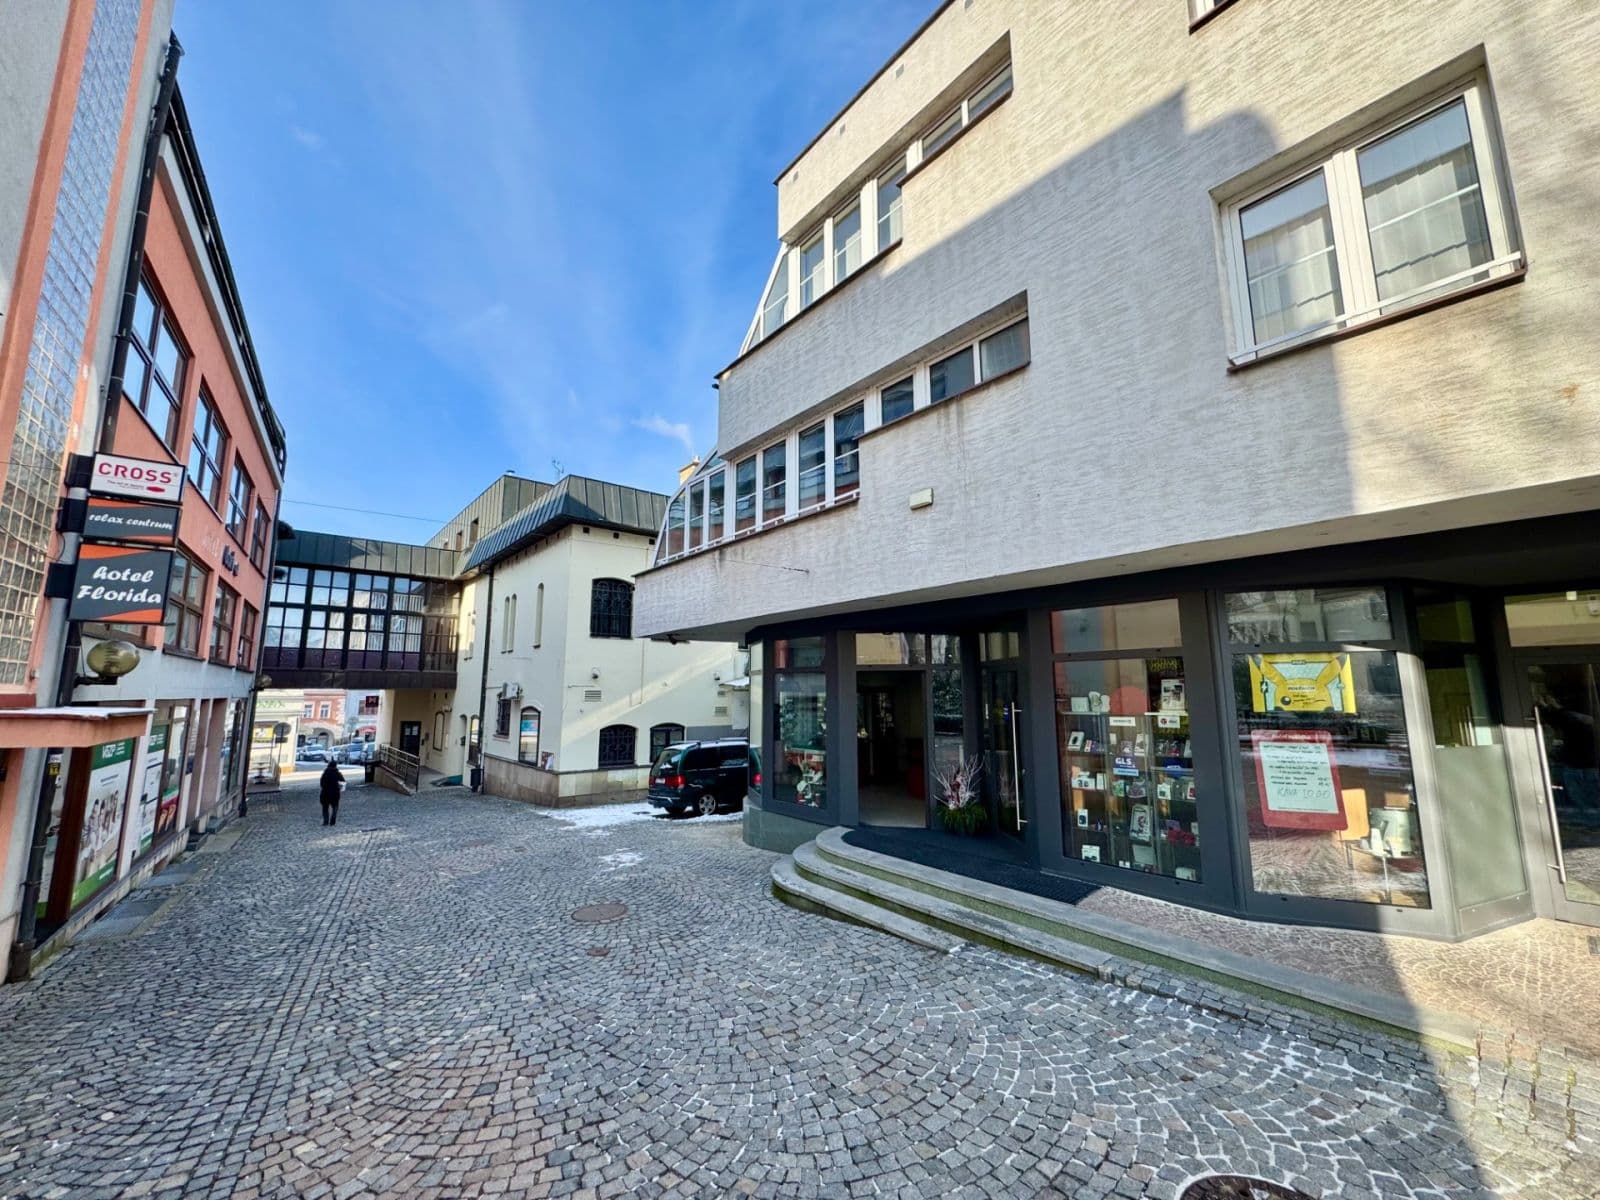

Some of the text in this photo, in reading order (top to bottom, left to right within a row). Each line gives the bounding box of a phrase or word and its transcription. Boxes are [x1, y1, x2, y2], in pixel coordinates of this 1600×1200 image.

[98, 462, 172, 484] CROSS
[88, 513, 173, 530] relax centrum
[92, 565, 154, 583] hotel
[76, 585, 162, 604] Florida
[1115, 757, 1132, 765] GLS
